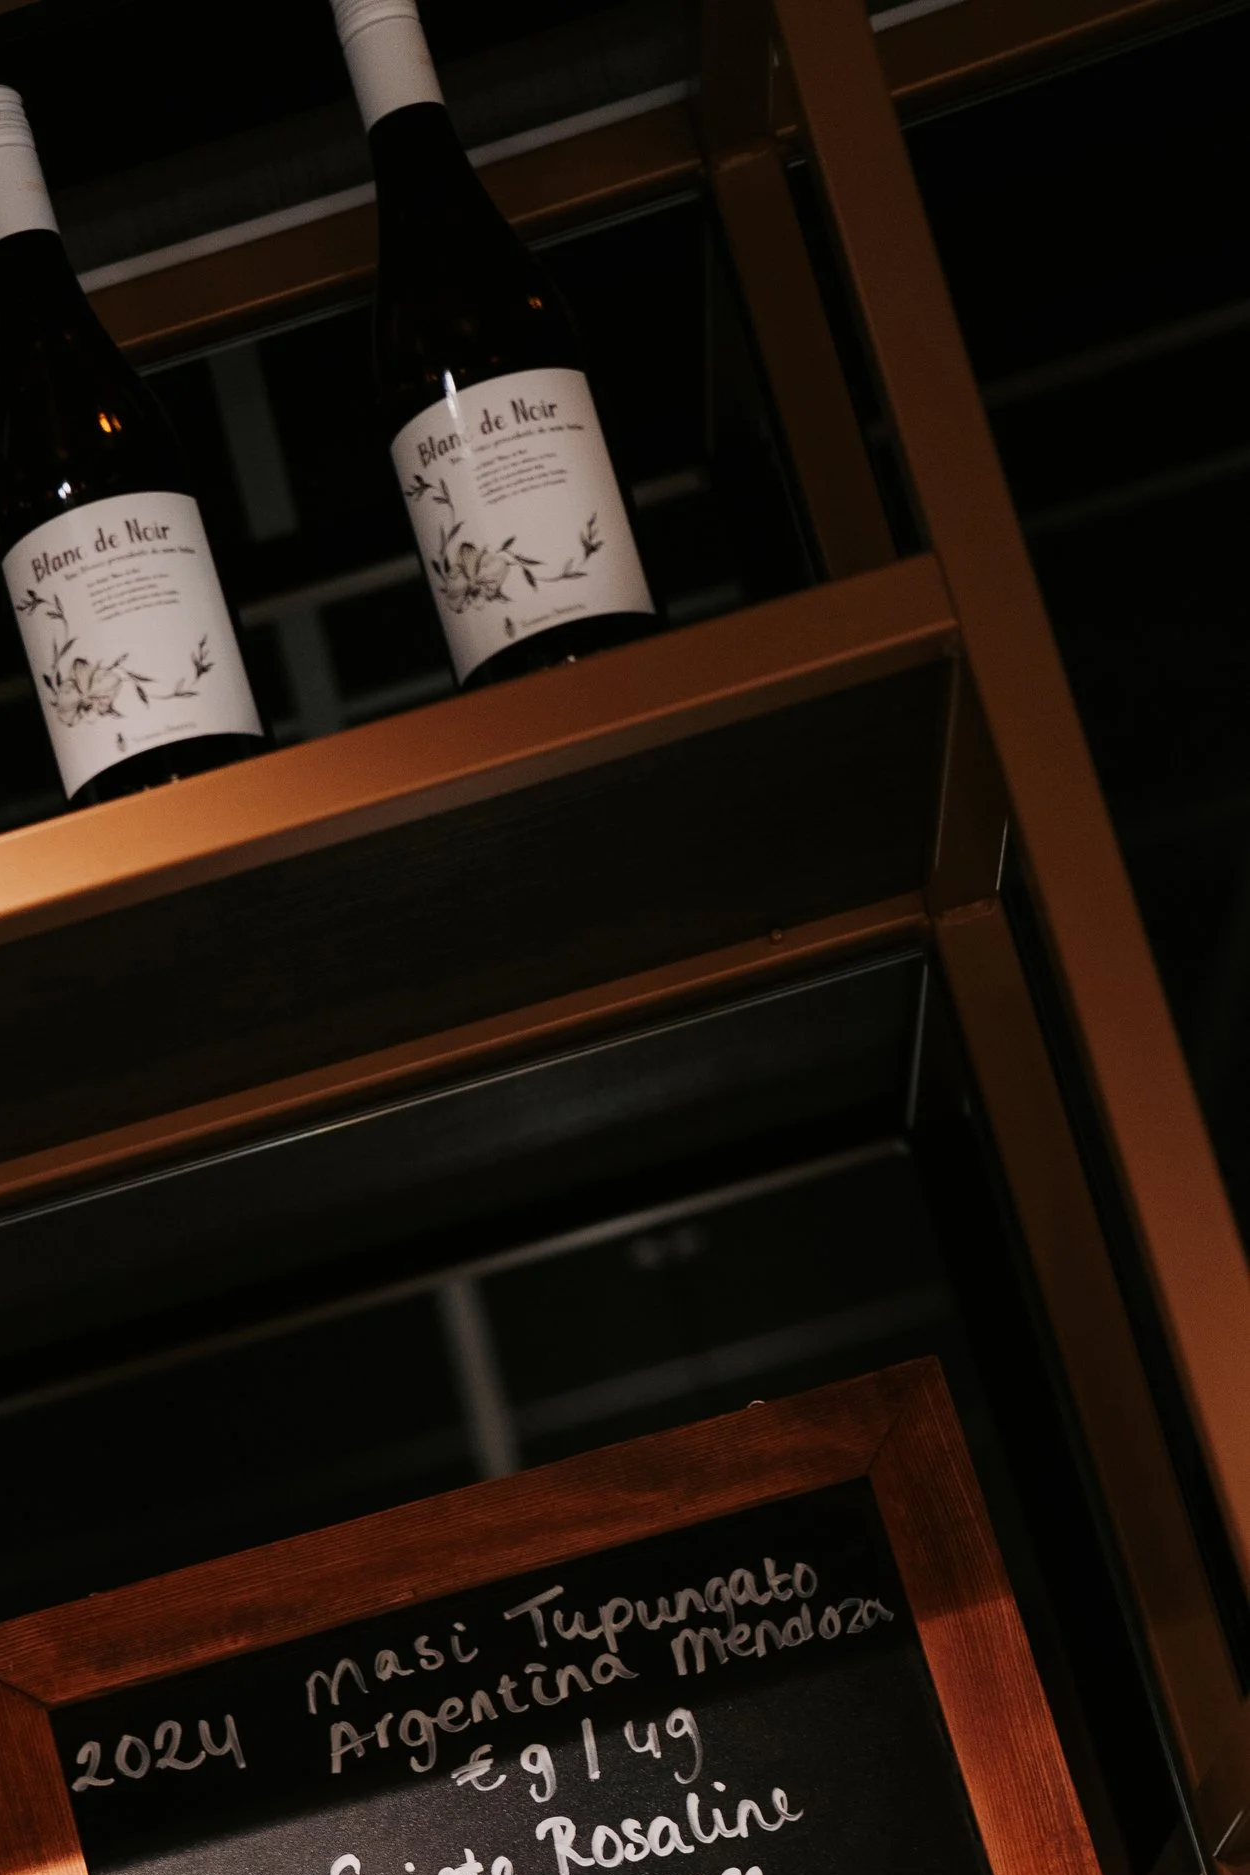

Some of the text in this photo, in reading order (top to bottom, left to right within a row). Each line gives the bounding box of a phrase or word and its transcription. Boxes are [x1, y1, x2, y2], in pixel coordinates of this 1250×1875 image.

[479, 409, 505, 436] de
[511, 398, 558, 425] Noir
[31, 546, 82, 583] Blanc
[94, 528, 118, 553] de
[125, 518, 170, 544] Noir
[307, 1560, 819, 1717] Masi Tupungato
[72, 1714, 247, 1793] 2024
[328, 1652, 640, 1775] Argentina
